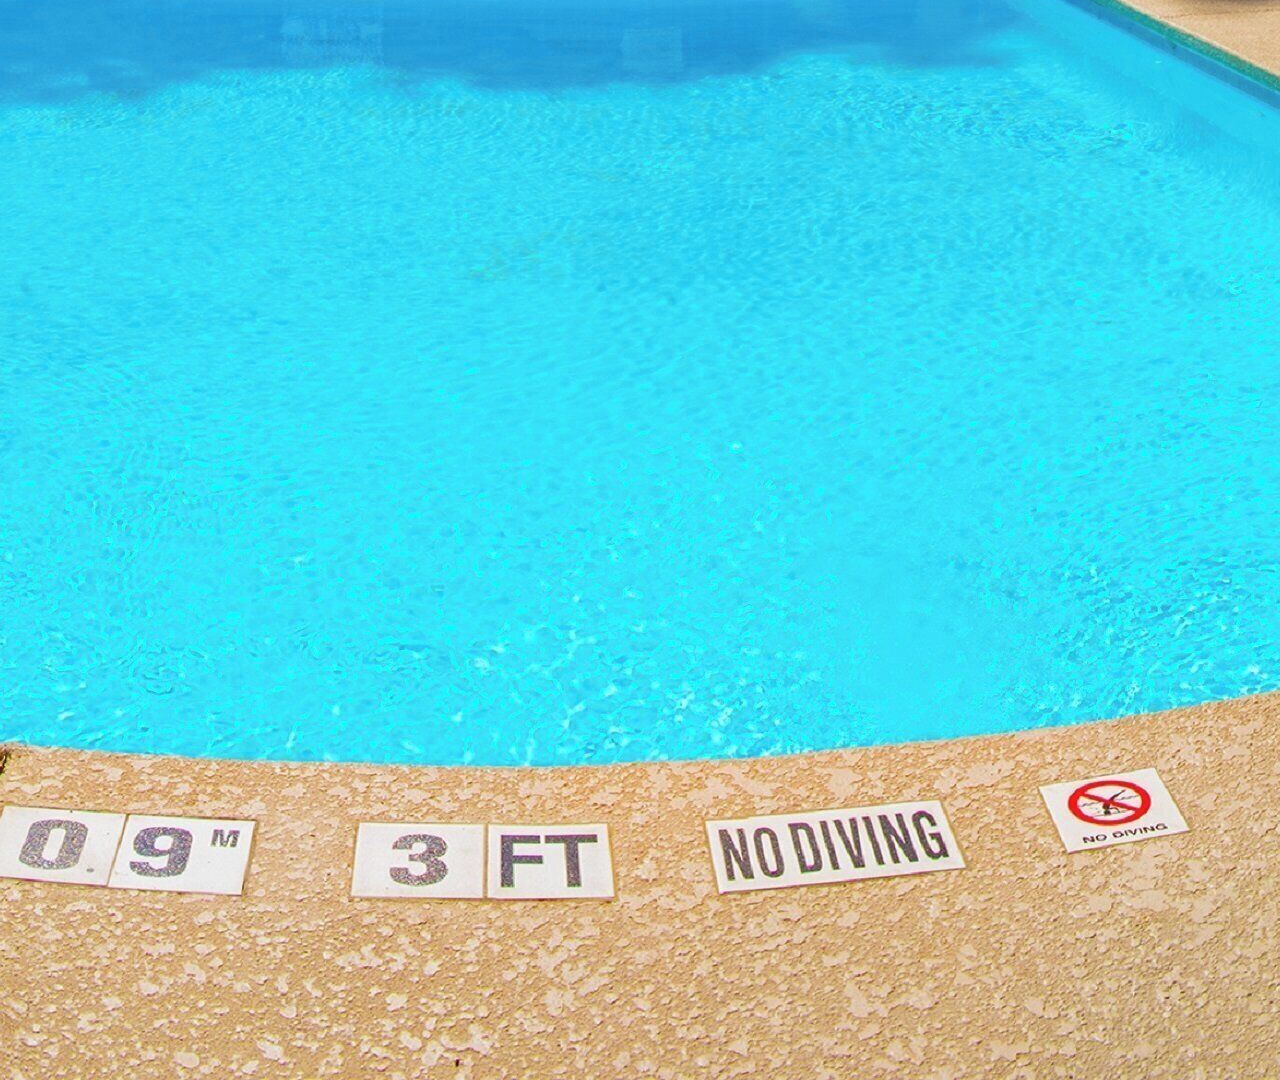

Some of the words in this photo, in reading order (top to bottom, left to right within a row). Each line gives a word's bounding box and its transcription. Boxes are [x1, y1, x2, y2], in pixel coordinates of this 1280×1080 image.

[389, 833, 449, 887] 3
[499, 833, 598, 888] FT
[720, 823, 785, 882] NO
[787, 809, 950, 875] DIVING
[1082, 833, 1108, 844] NO
[1112, 822, 1169, 839] DIVING
